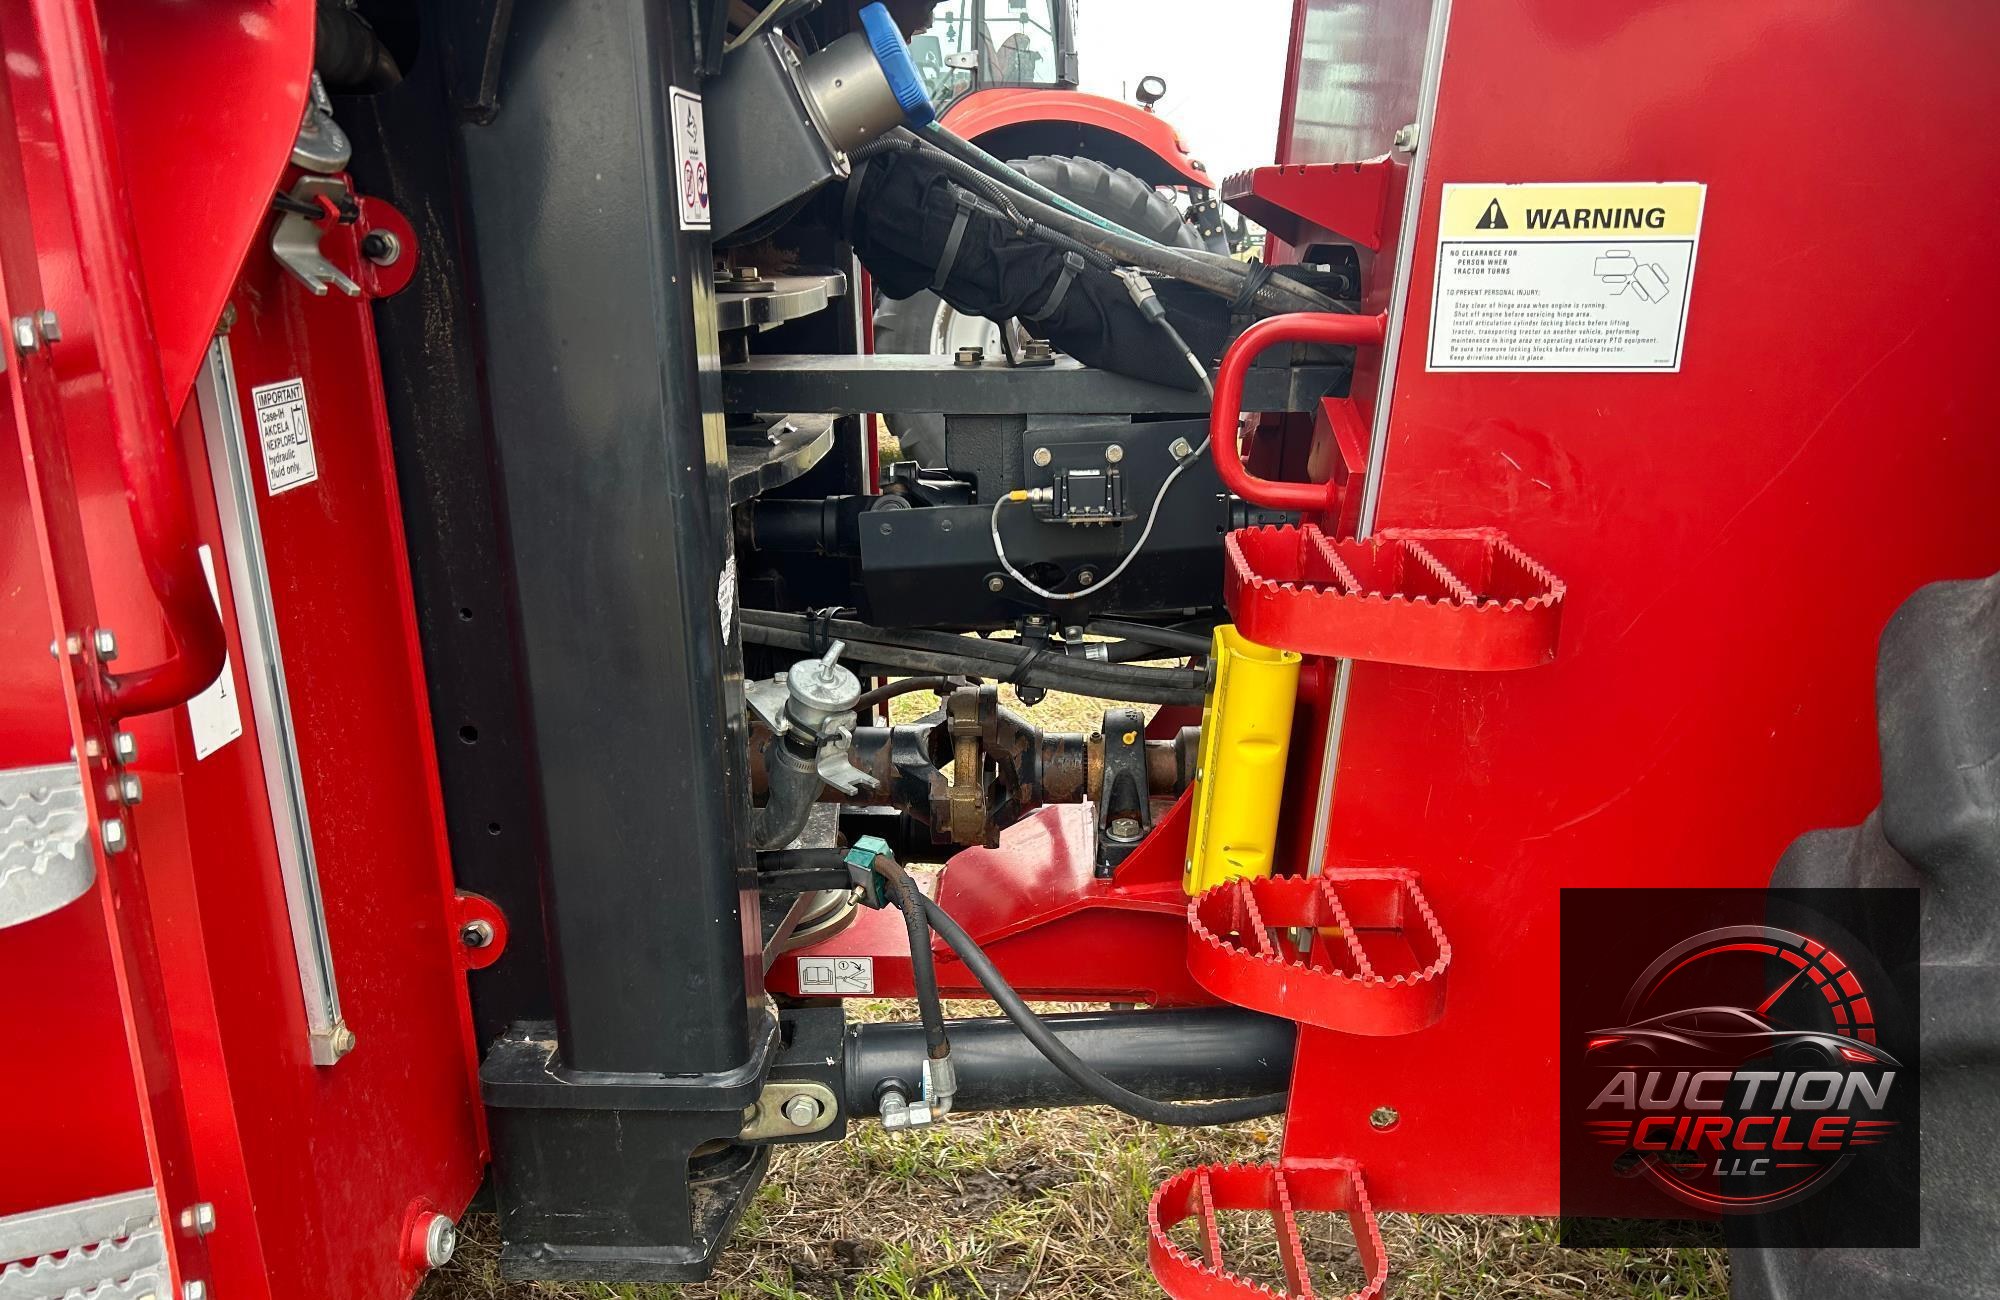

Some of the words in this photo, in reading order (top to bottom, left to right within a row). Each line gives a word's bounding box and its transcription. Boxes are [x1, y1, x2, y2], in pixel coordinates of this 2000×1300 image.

[1525, 208, 1666, 230] WARNING
[259, 386, 300, 406] IMPORTANT
[261, 408, 285, 424] Case-IH
[264, 421, 289, 437] AKCELA
[266, 434, 296, 451] NEXPLORE
[269, 448, 295, 466] hydraulic
[271, 466, 285, 479] fluid
